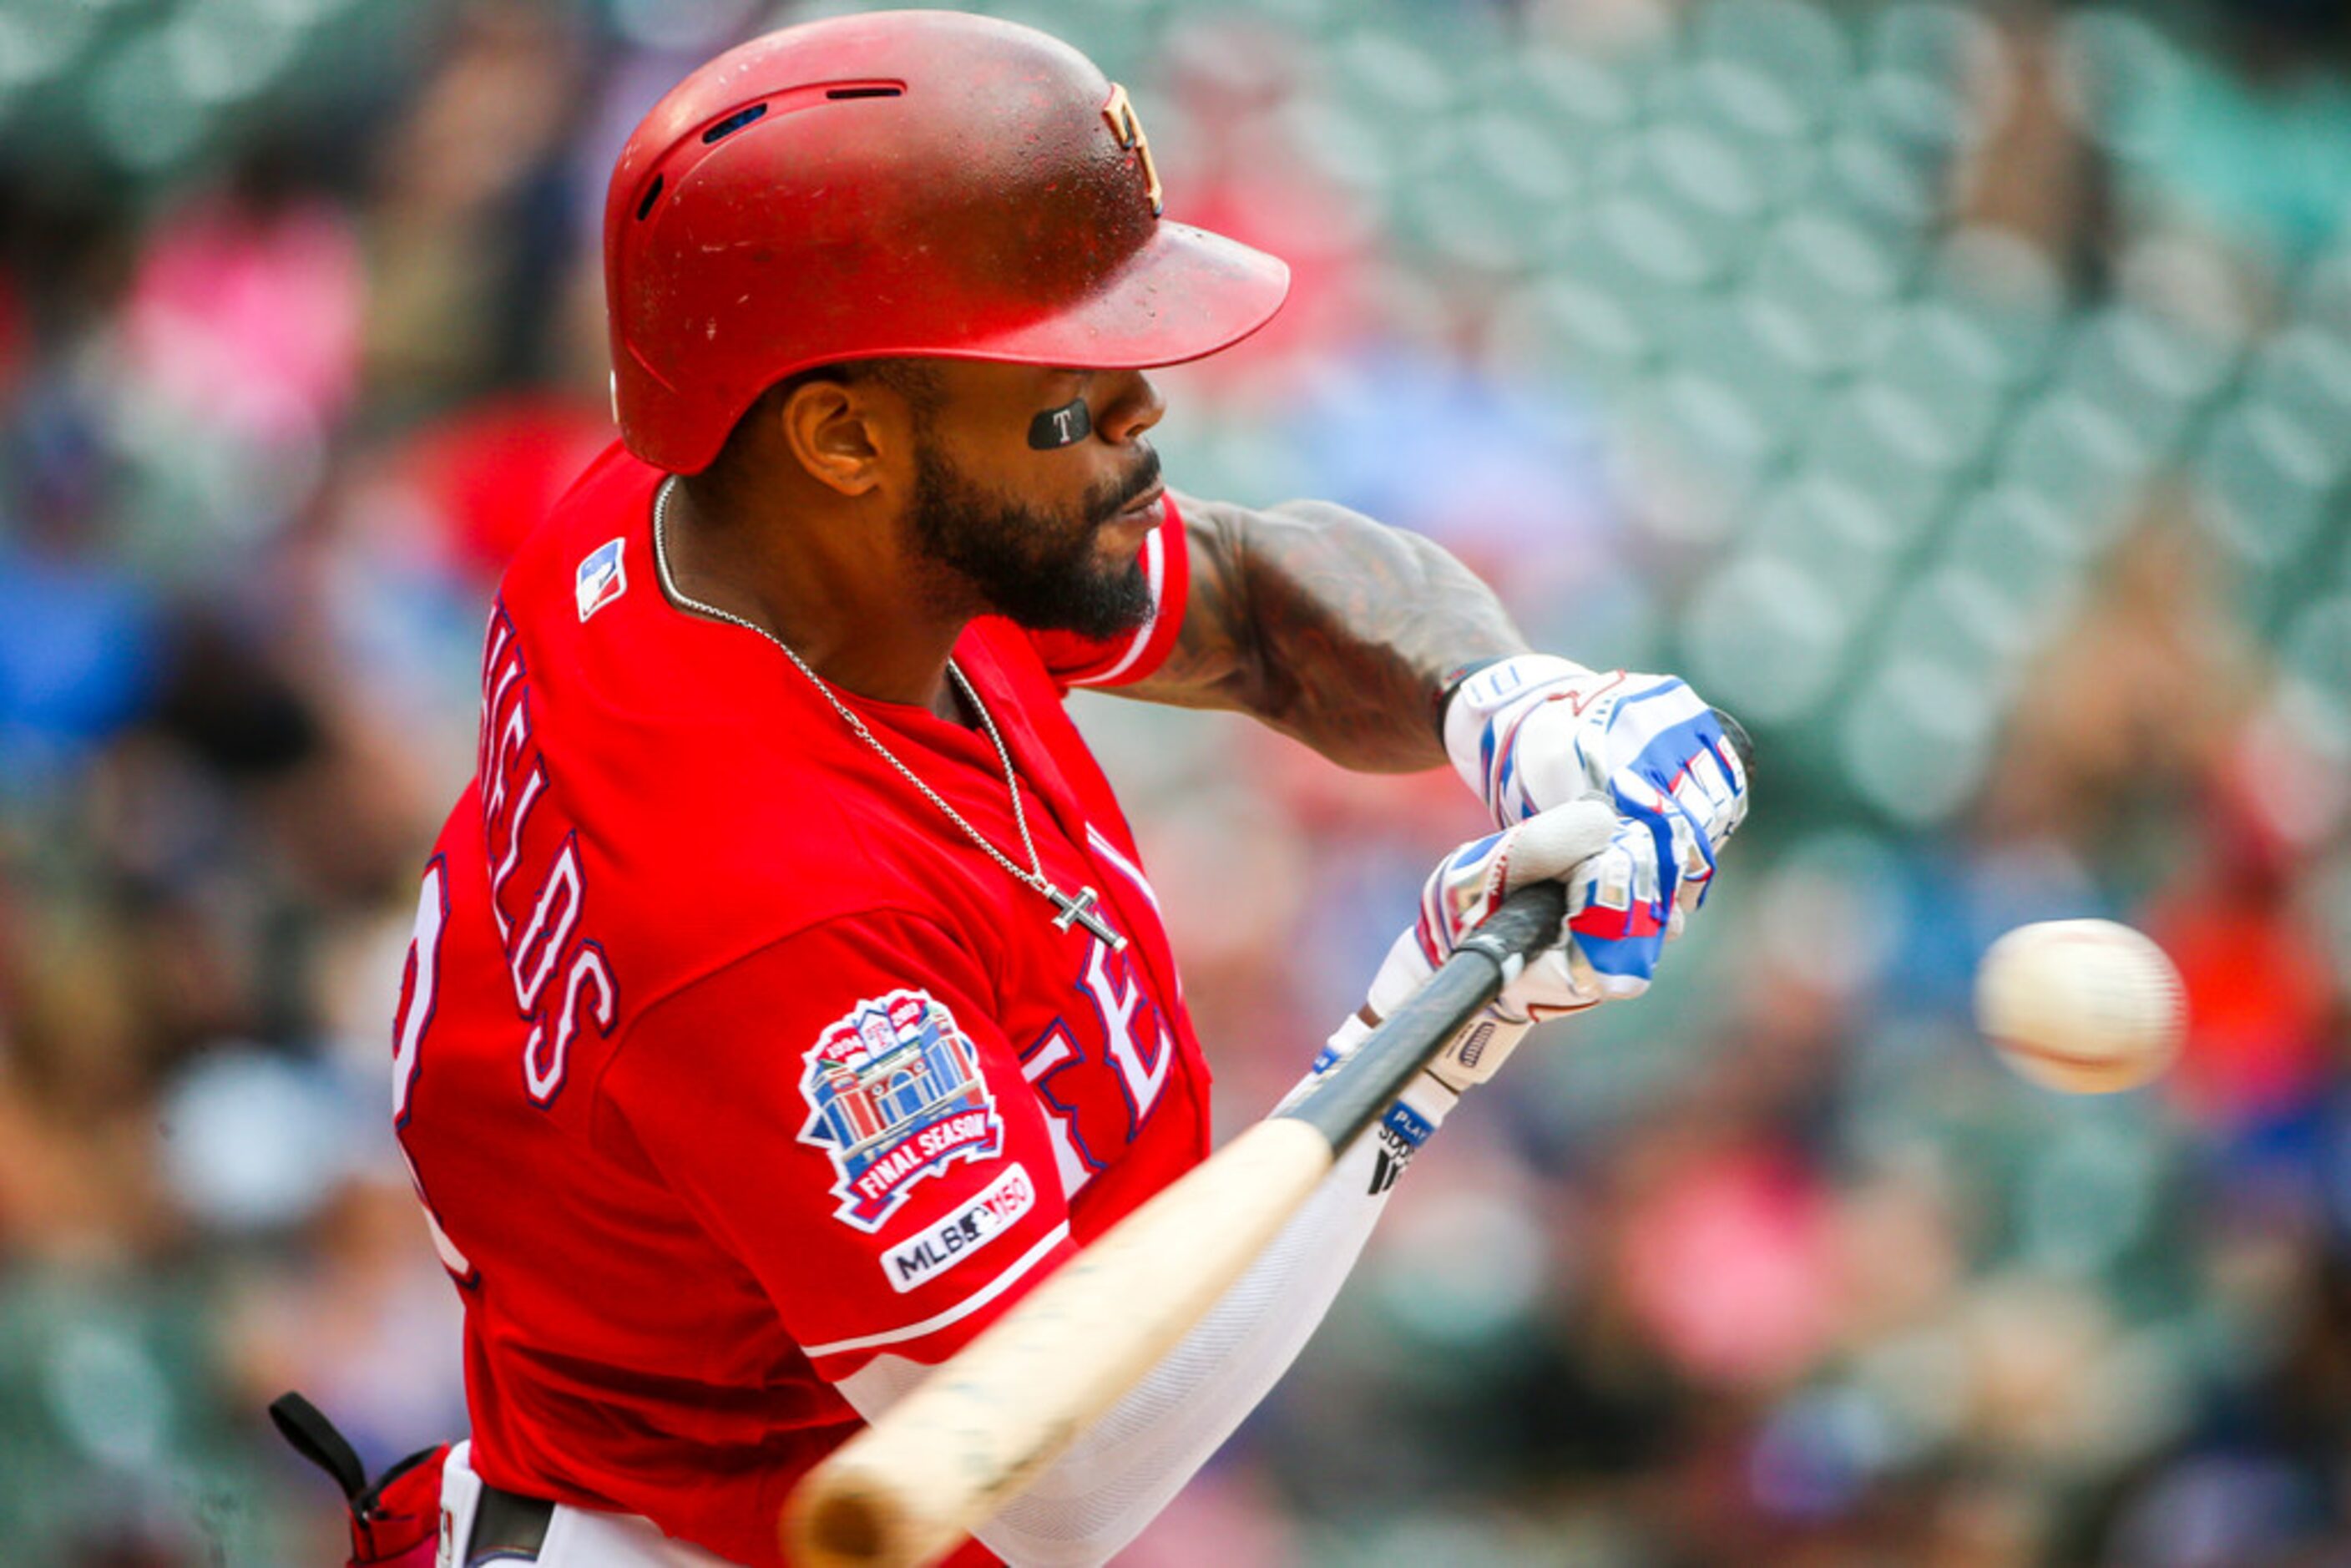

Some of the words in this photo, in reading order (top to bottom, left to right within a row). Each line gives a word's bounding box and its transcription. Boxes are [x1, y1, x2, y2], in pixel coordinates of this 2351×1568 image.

[1052, 409, 1072, 444] T
[857, 1145, 923, 1200] FINAL
[918, 1112, 986, 1156] SEASON
[896, 1225, 964, 1282] MLB
